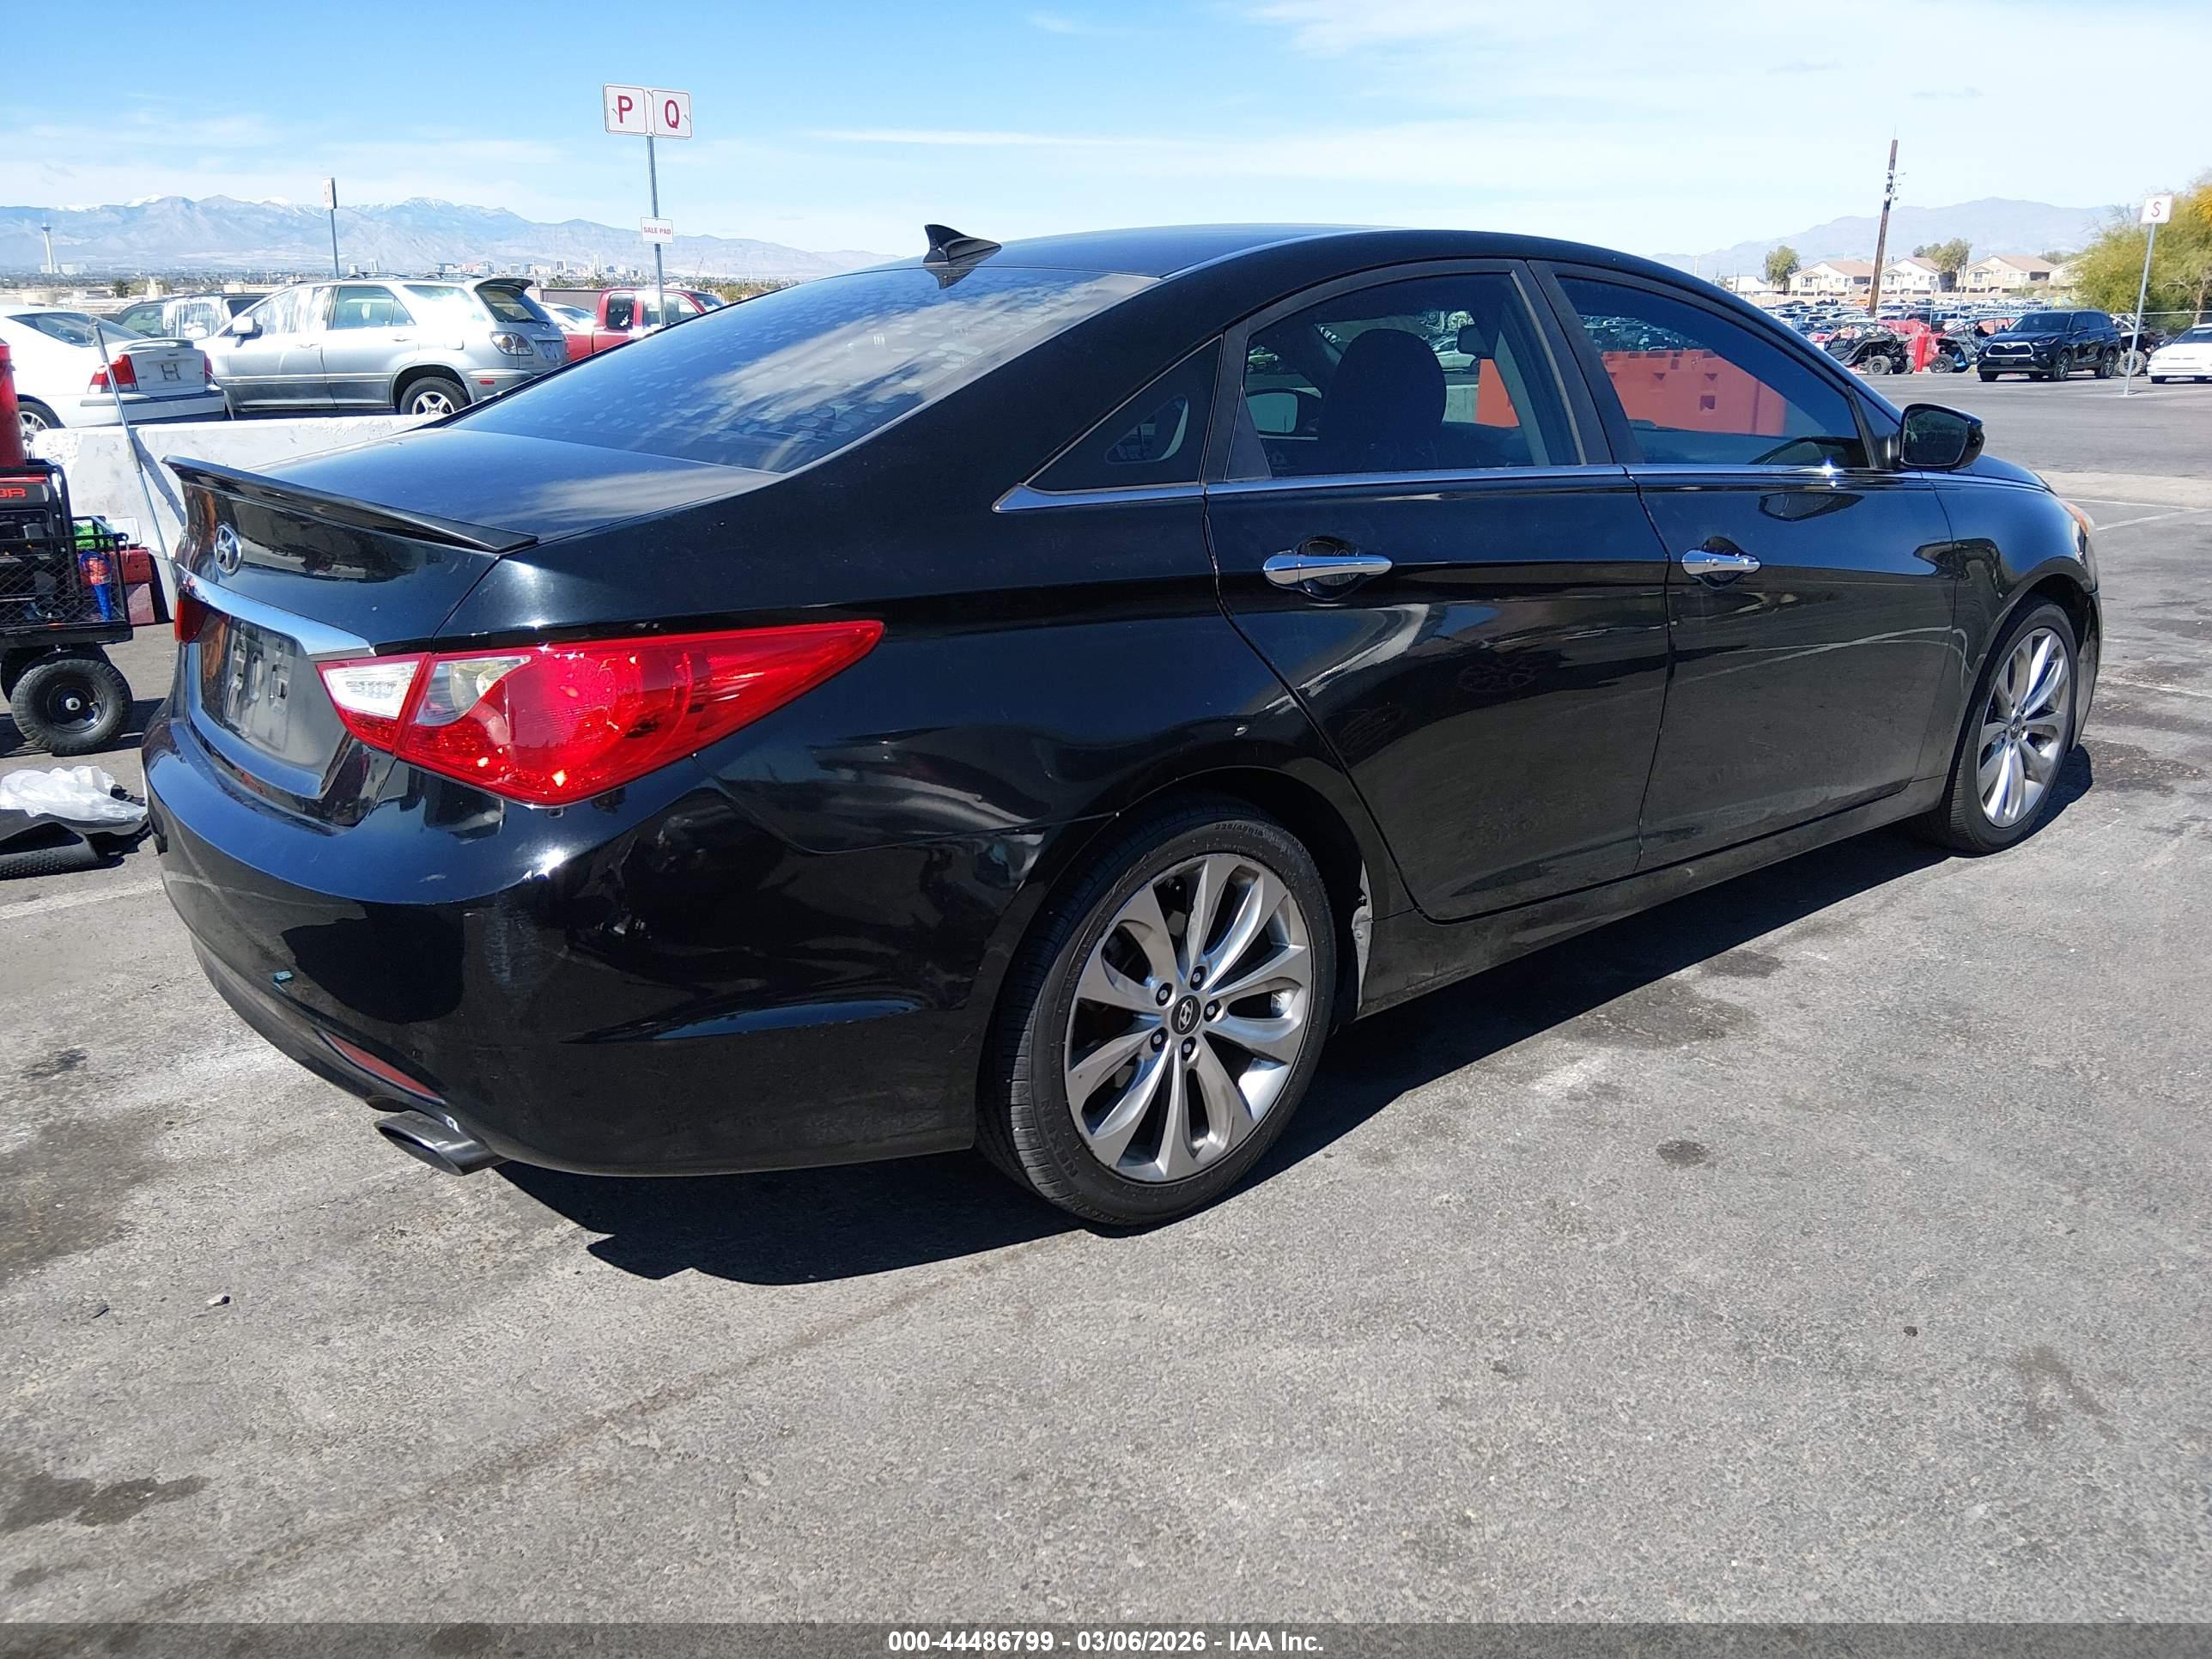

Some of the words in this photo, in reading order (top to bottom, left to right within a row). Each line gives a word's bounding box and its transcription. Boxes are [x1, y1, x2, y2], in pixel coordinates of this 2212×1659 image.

[617, 95, 633, 124] P
[665, 100, 680, 129] Q
[2151, 202, 2161, 217] S
